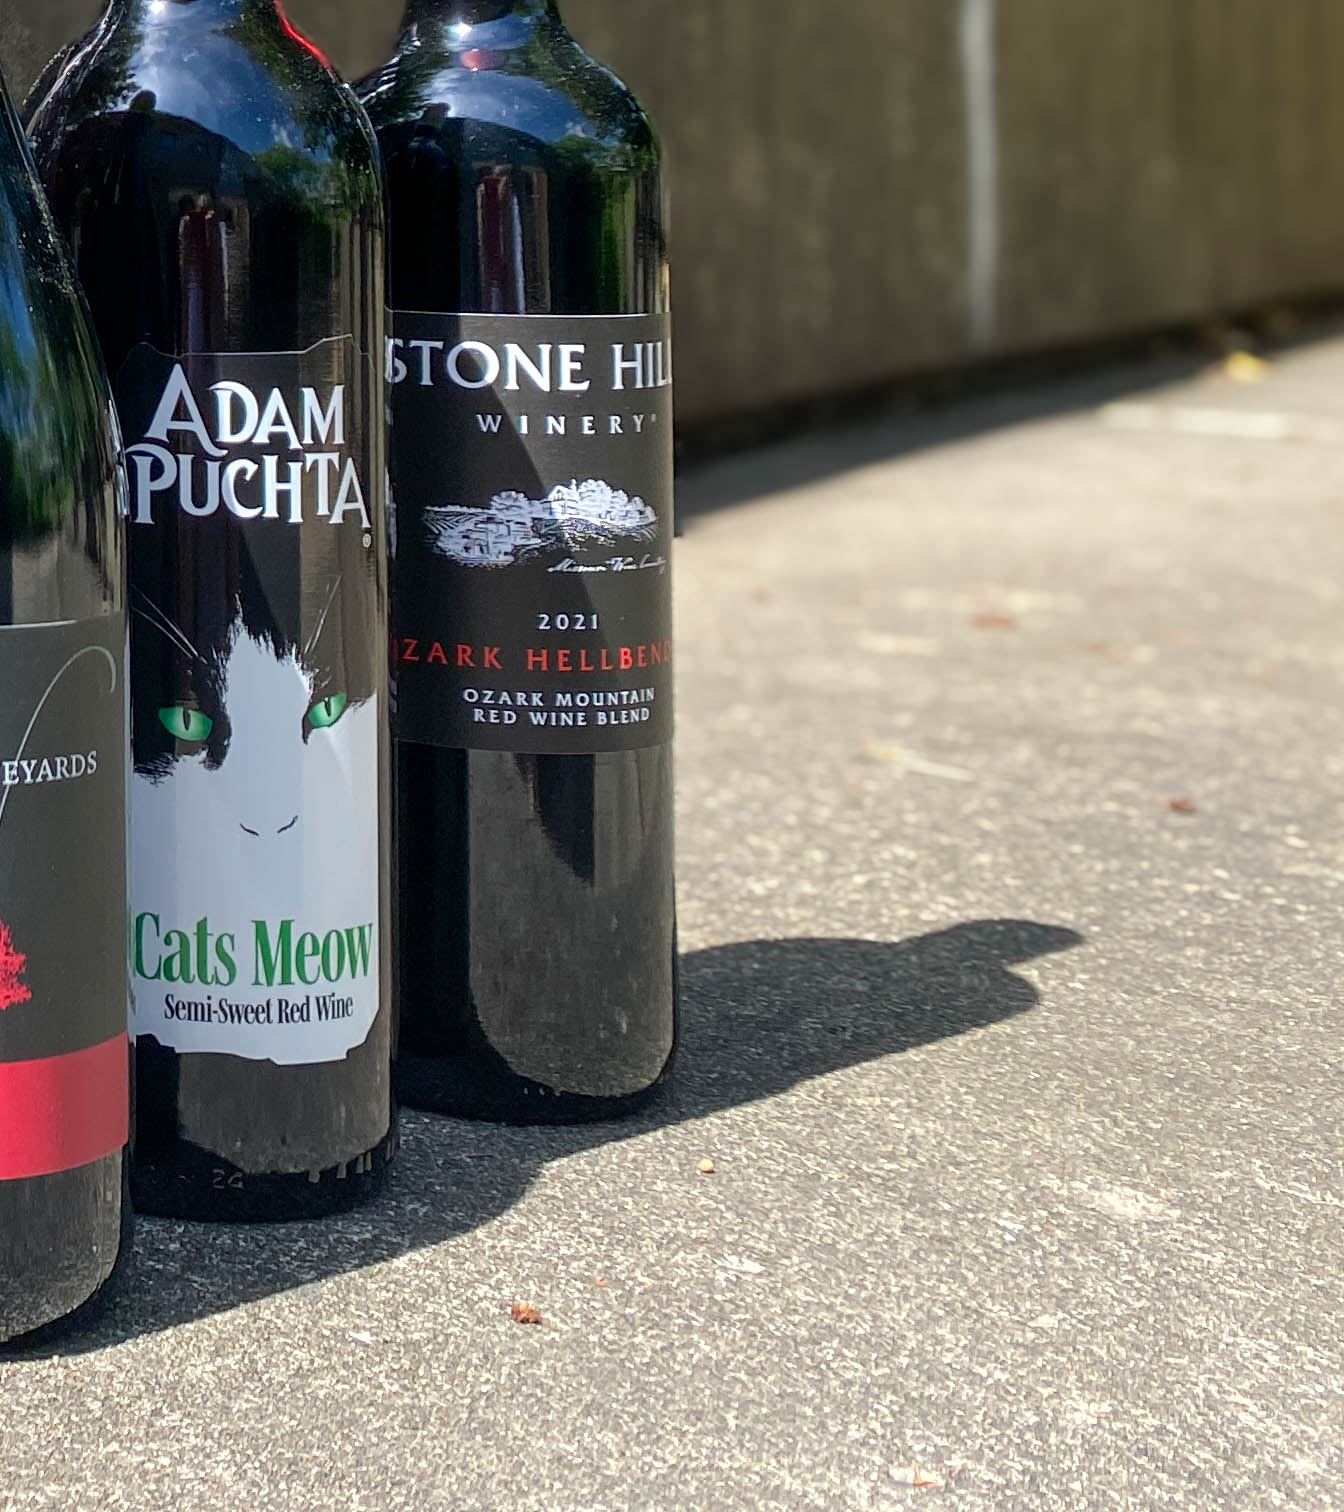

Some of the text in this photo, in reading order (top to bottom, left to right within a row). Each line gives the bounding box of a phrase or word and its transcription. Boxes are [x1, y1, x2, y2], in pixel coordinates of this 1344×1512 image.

[385, 336, 671, 392] STONE HIL
[143, 363, 344, 457] ADAM
[475, 414, 646, 436] WINERY
[125, 443, 371, 528] PUCHTA
[538, 614, 599, 630] 2021
[462, 688, 655, 707] OZARK MOUNTAIN
[474, 707, 650, 726] RED WINE BLEND
[135, 912, 374, 987] Cats Meow
[164, 991, 354, 1025] Semi-Sweet Red Wine
